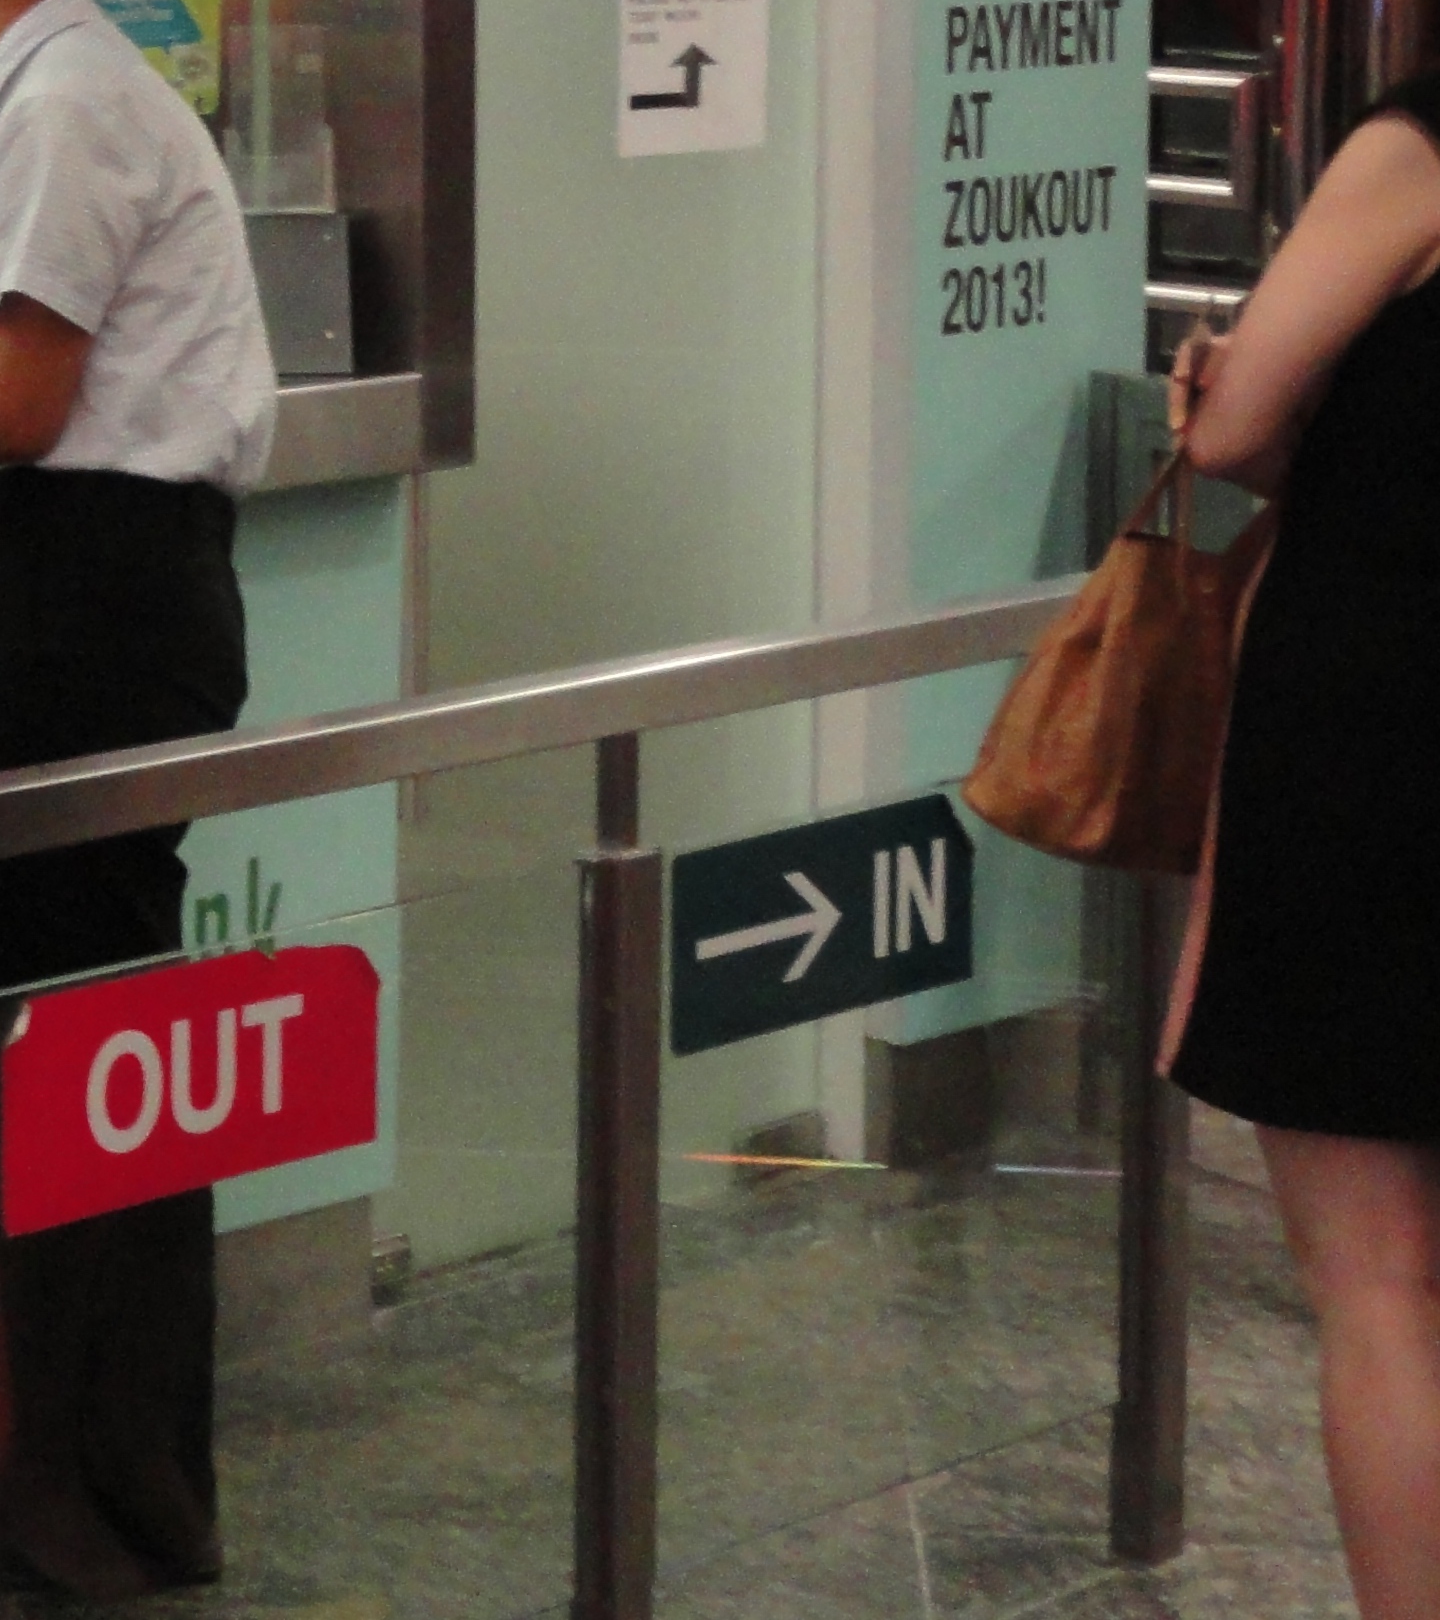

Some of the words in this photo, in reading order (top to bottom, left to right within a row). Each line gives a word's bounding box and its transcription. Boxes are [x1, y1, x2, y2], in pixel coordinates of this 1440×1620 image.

[943, 90, 993, 163] AT
[942, 165, 1117, 250] ZOUKOUT
[940, 257, 1048, 336] 2013!
[871, 837, 949, 961] IN
[84, 991, 306, 1155] OUT
